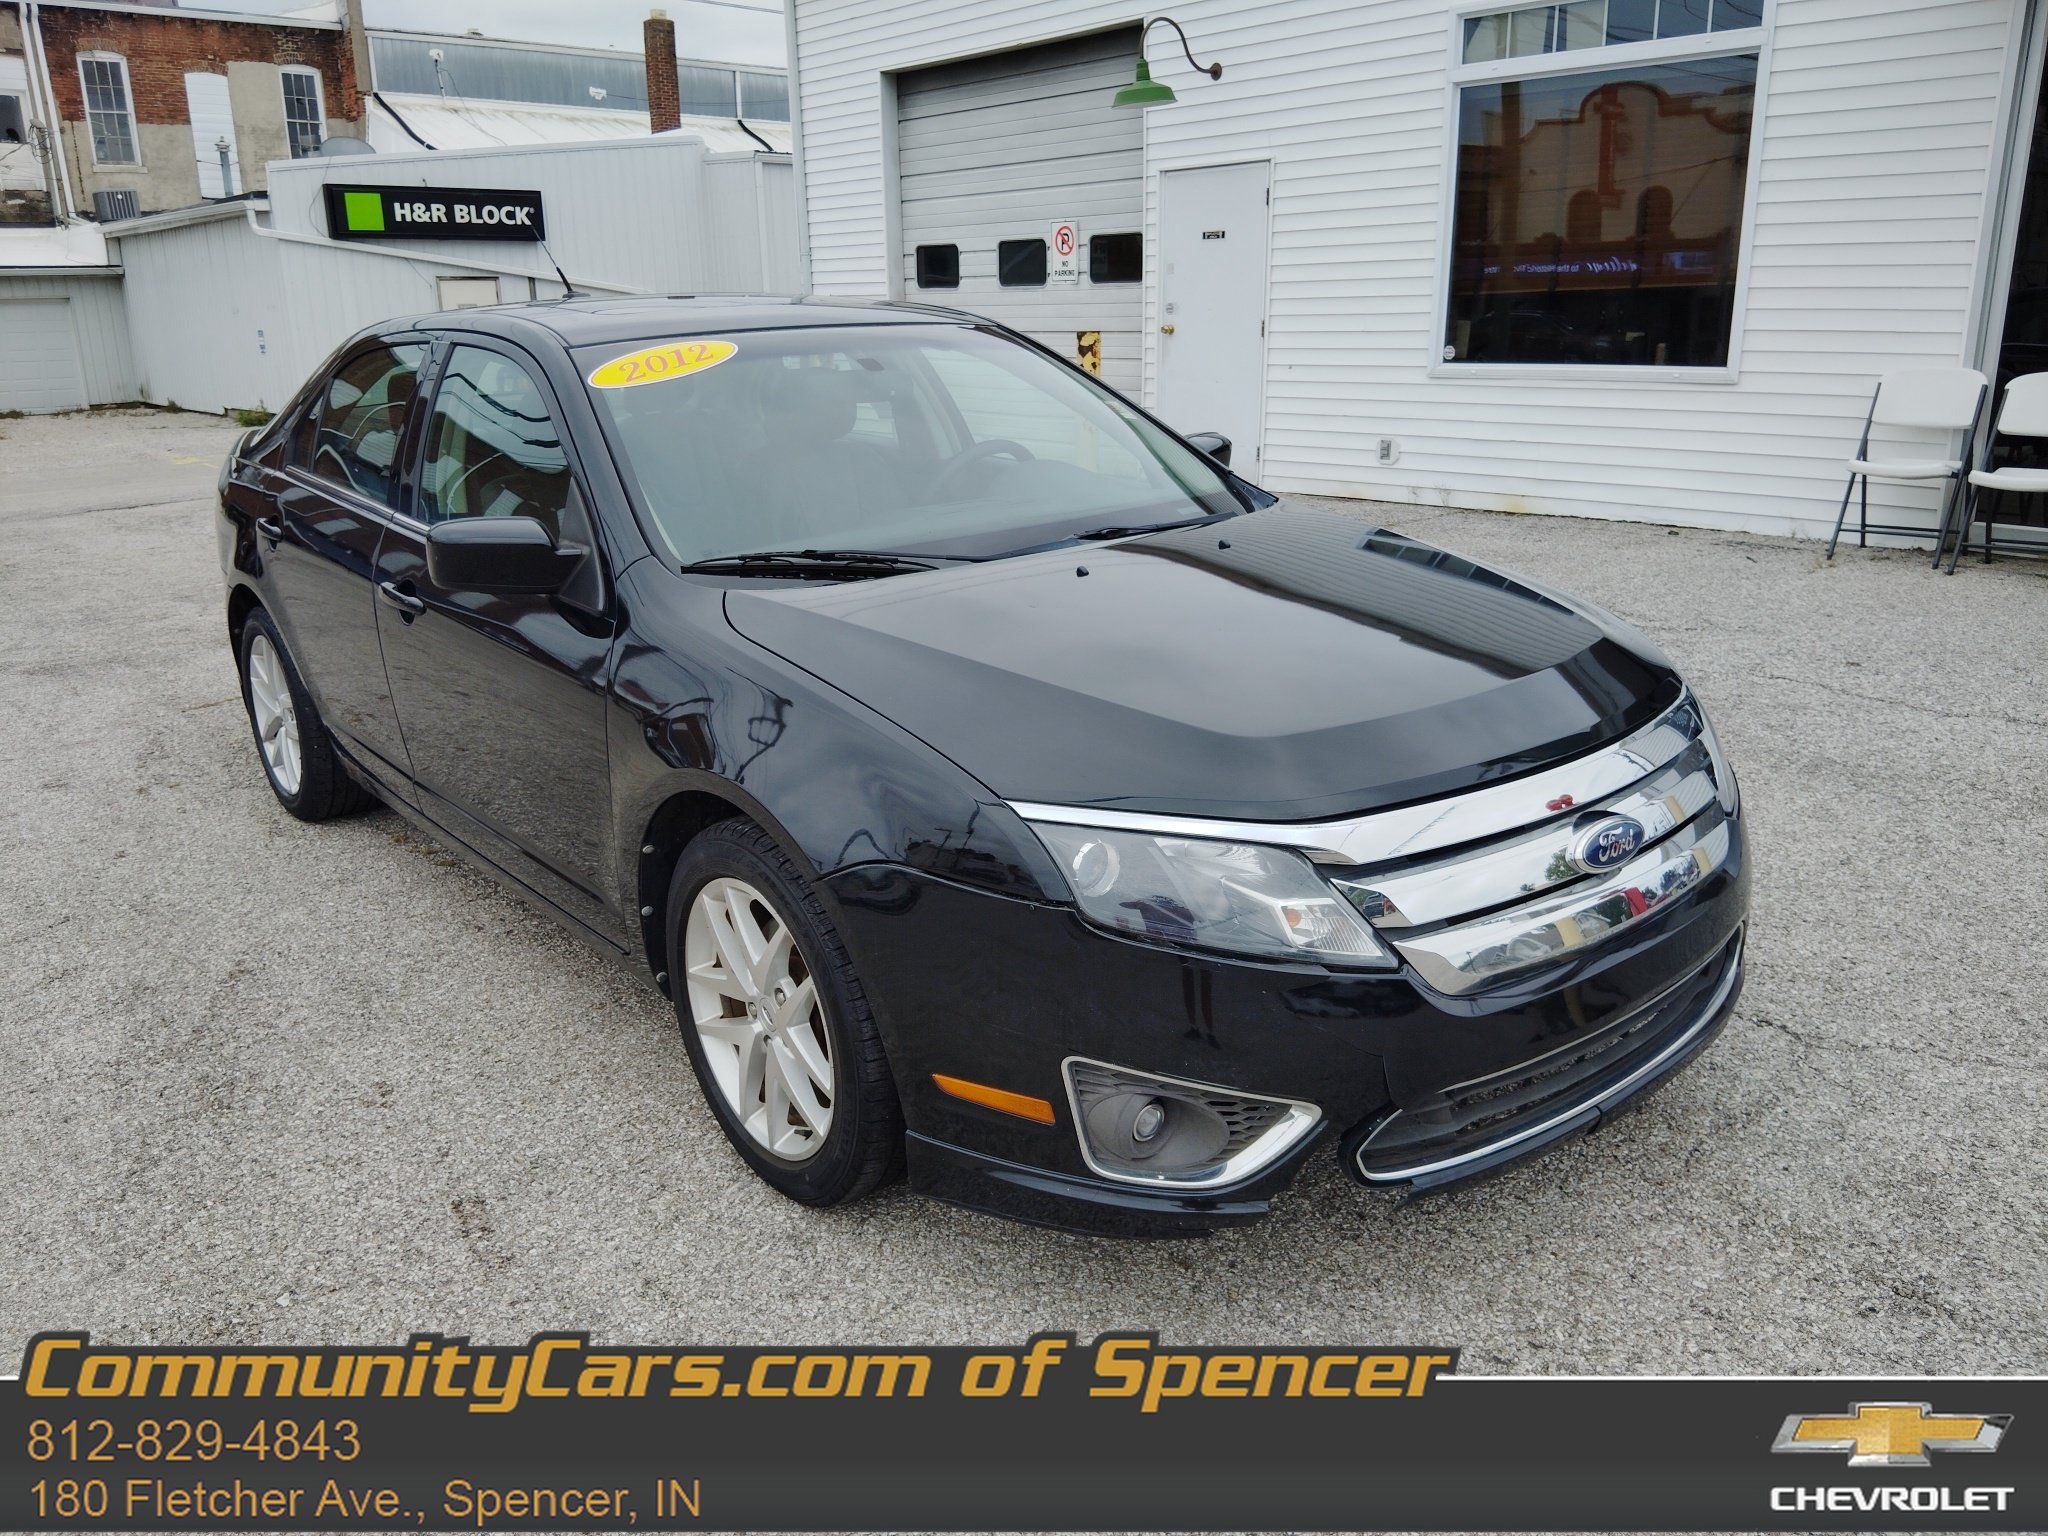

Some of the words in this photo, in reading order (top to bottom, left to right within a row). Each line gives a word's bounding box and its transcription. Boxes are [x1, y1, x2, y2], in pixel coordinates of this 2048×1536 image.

[393, 202, 448, 223] H&R
[619, 344, 714, 383] 2012
[1598, 826, 1635, 862] Ford
